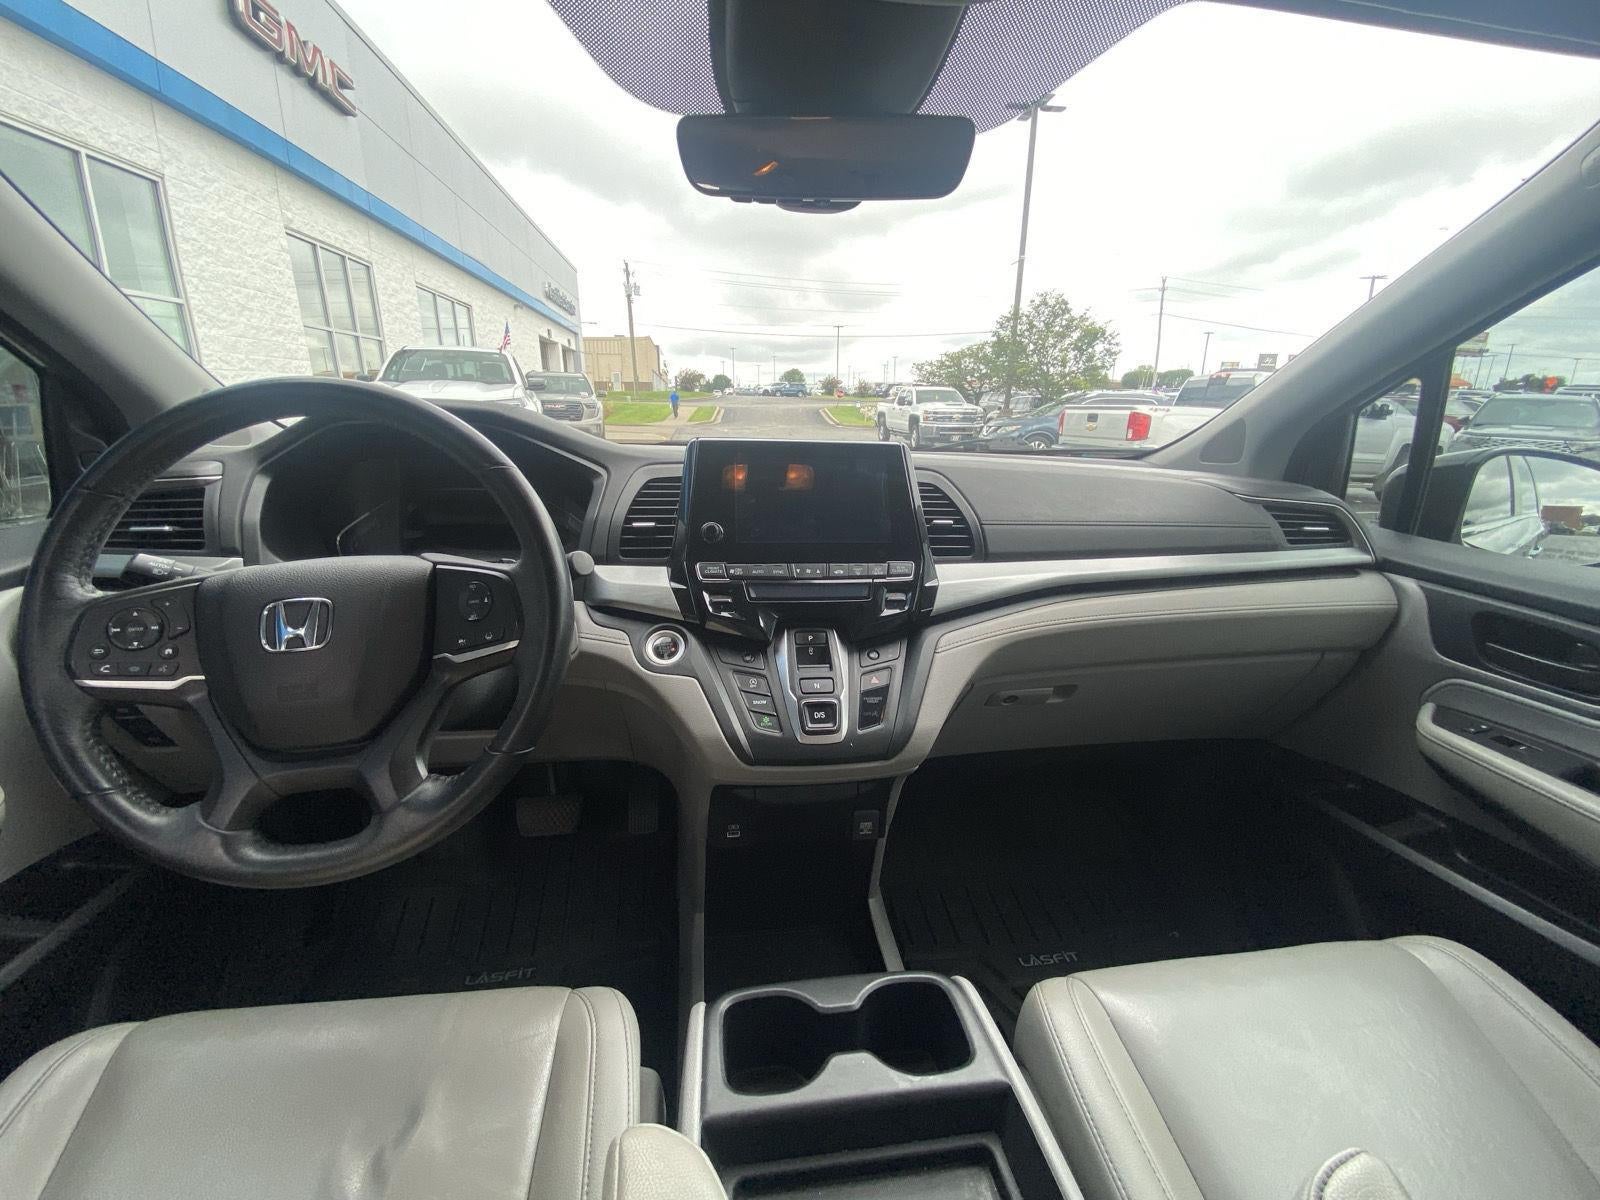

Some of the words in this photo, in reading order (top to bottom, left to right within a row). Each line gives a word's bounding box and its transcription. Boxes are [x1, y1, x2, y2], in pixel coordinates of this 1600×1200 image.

[230, 0, 357, 117] GMC
[813, 711, 826, 719] D/S
[1018, 950, 1079, 967] LASFIT
[464, 967, 537, 985] LASFIT
